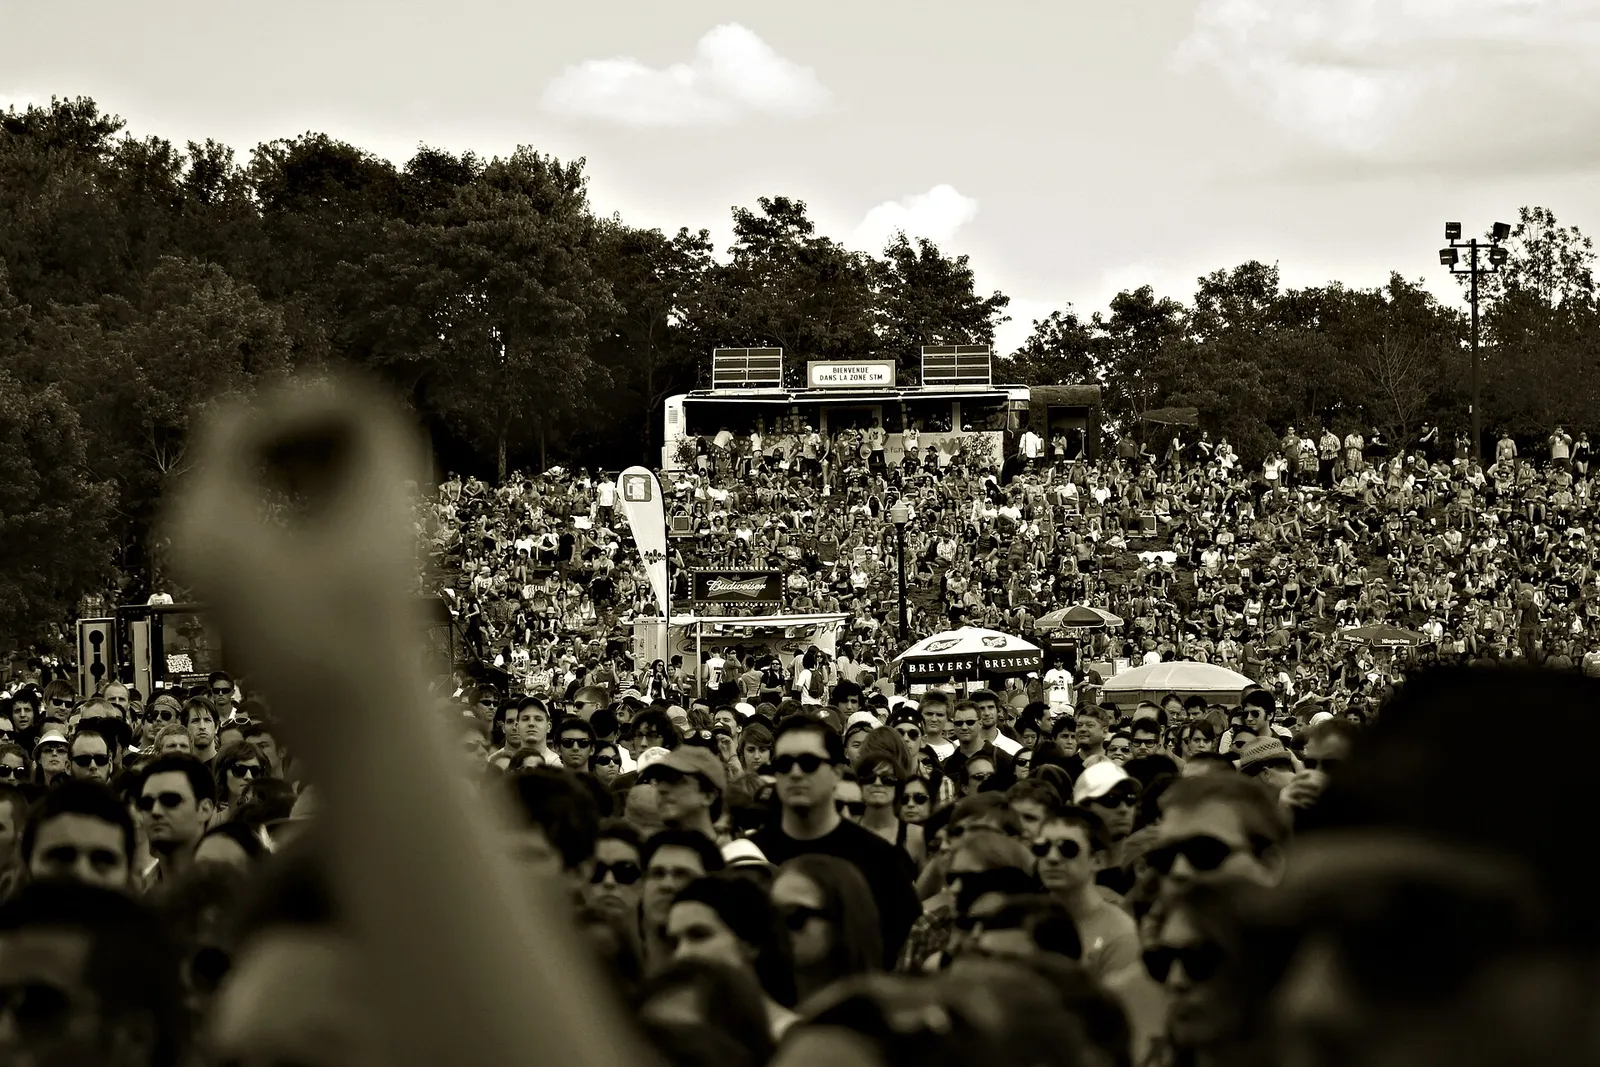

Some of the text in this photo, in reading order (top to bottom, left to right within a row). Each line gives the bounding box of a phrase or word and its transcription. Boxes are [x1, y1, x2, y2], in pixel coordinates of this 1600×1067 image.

[706, 580, 767, 591] Budweiser
[909, 661, 973, 673] BREYERS
[984, 656, 1039, 669] BREYERS
